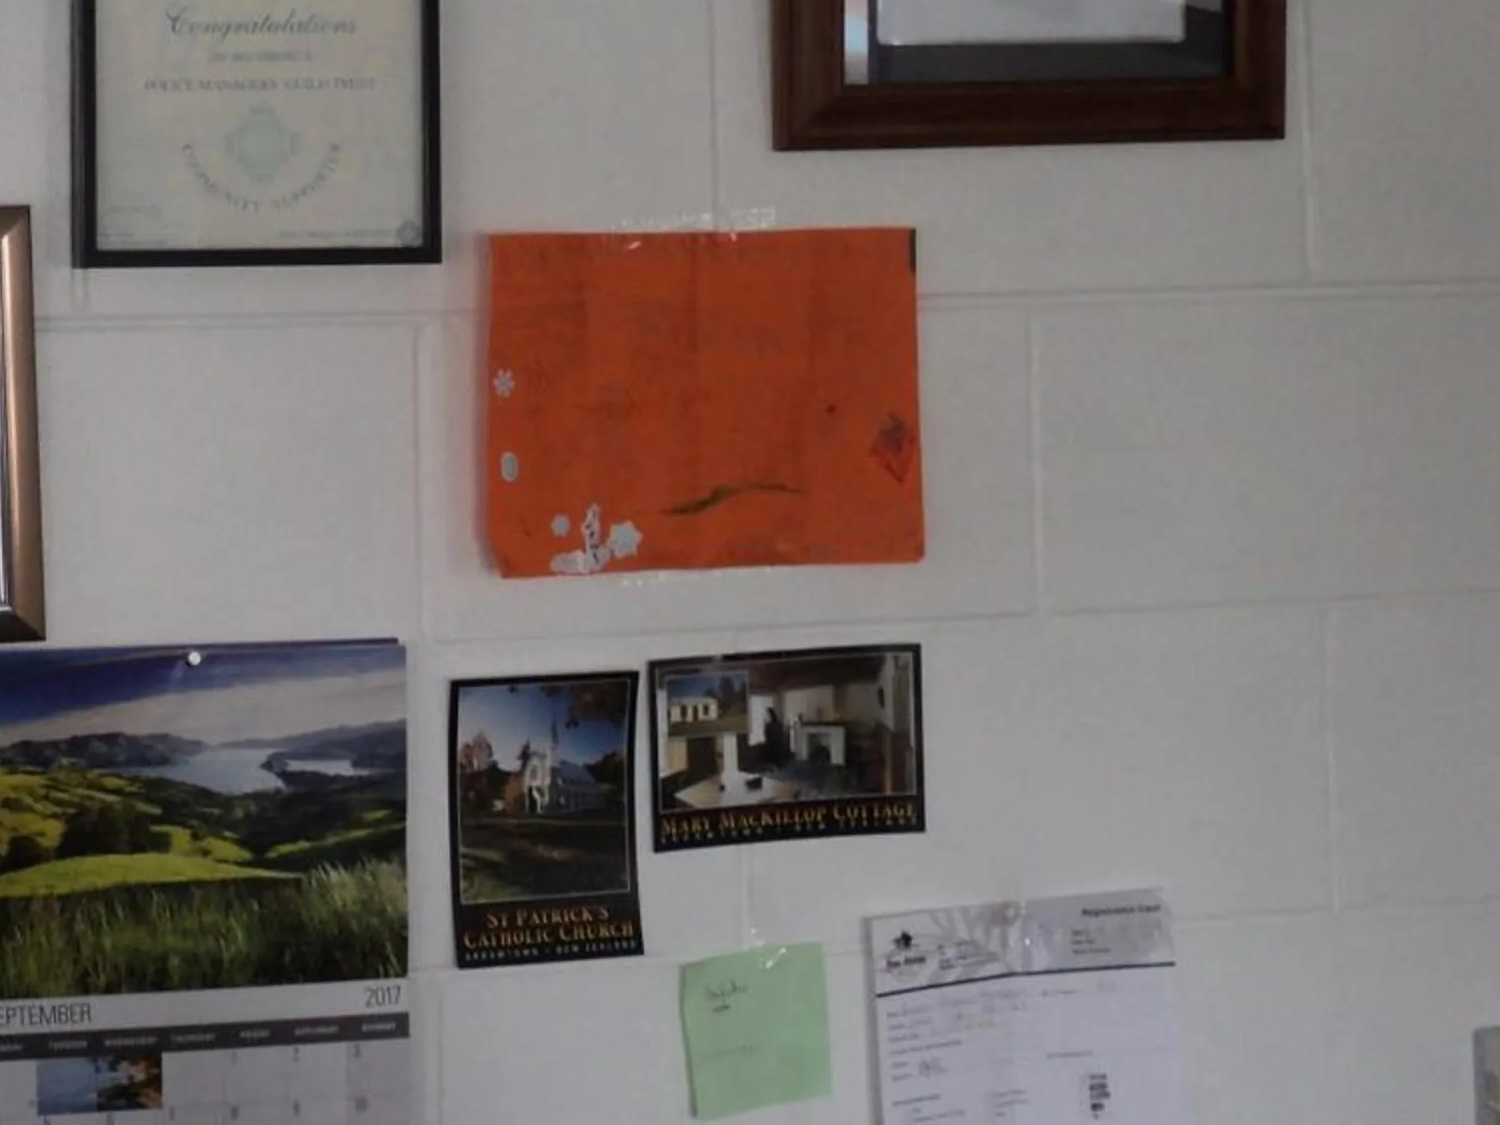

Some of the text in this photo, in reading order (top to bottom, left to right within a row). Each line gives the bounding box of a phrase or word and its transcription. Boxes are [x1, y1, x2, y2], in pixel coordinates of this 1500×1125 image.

[164, 4, 357, 41] Congratulations
[660, 815, 711, 837] MARY
[832, 801, 917, 821] COTTAGE
[463, 919, 635, 950] CATHOLIC CHURCH
[365, 986, 401, 1007] 2017
